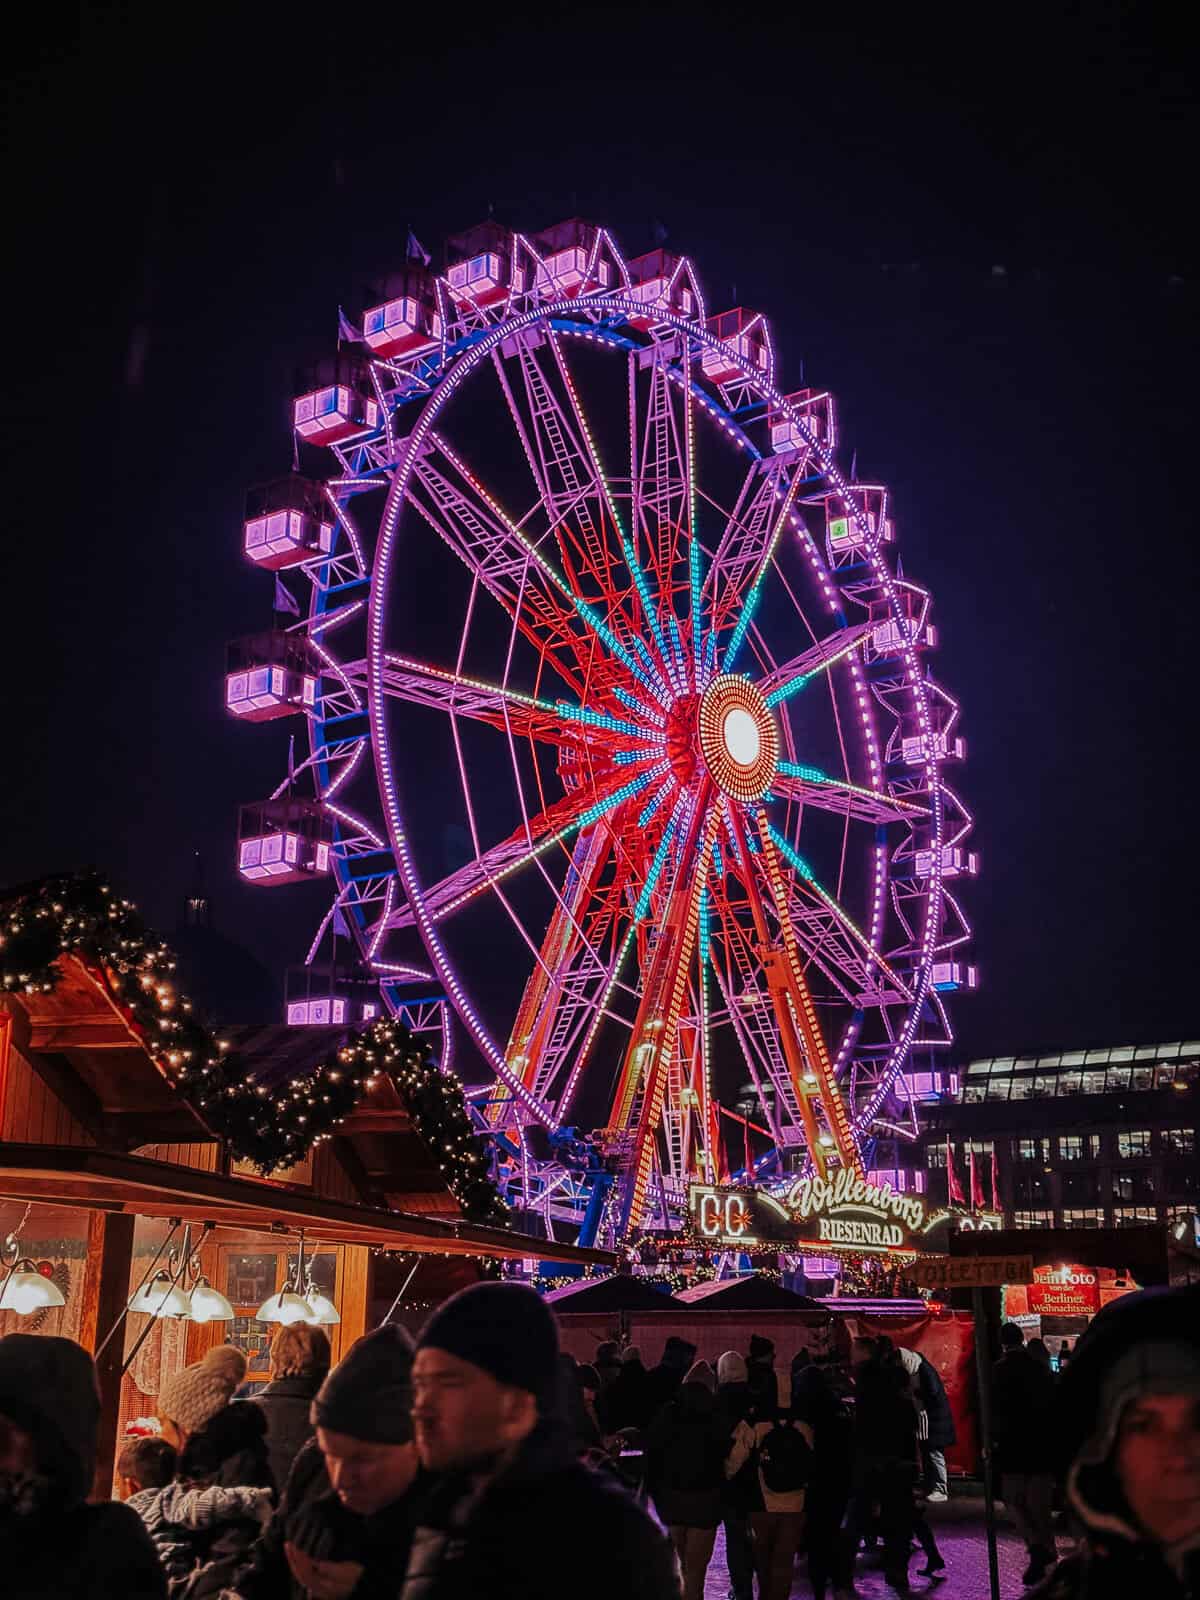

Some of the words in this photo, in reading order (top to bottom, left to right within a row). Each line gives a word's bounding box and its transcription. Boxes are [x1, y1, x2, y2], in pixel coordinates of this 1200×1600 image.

[788, 1167, 924, 1230] Willenborg
[819, 1219, 903, 1246] RIESENRAD
[1061, 1271, 1096, 1285] Foto
[1044, 1294, 1084, 1304] Berliner
[1032, 1304, 1096, 1314] Weihnachtszeit
